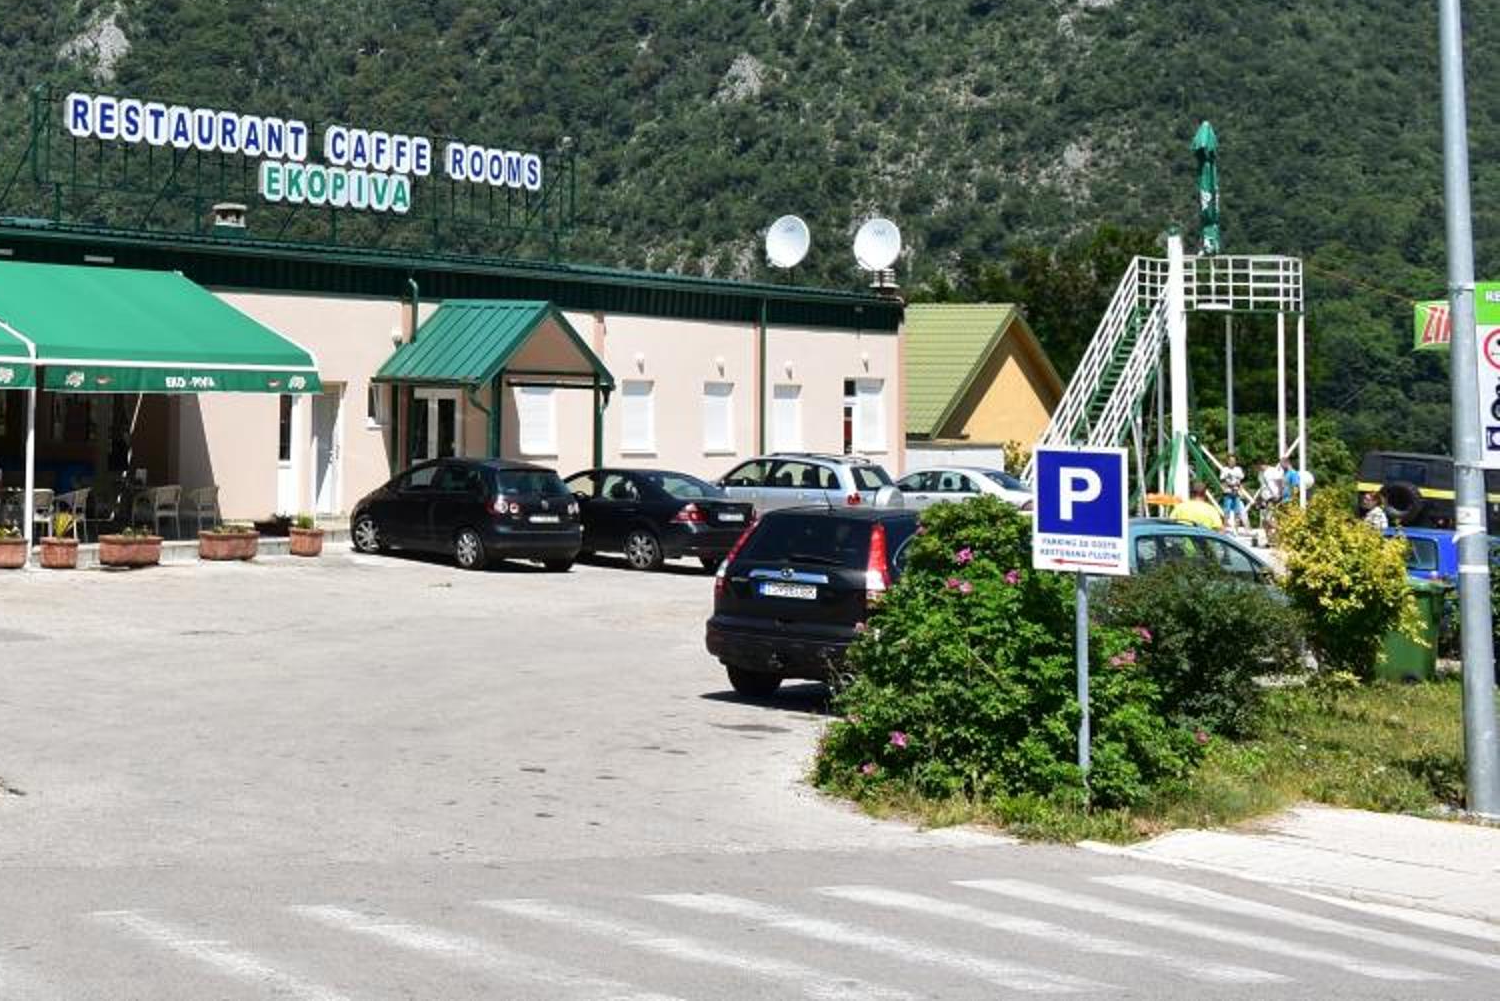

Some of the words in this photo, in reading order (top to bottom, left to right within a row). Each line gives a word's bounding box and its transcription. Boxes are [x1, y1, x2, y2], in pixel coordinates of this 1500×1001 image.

[67, 94, 306, 160] RESTAURANT
[326, 126, 430, 175] CAFFE
[448, 146, 541, 190] ROOMS
[262, 161, 411, 212] EKOPIVA
[1059, 466, 1102, 521] P
